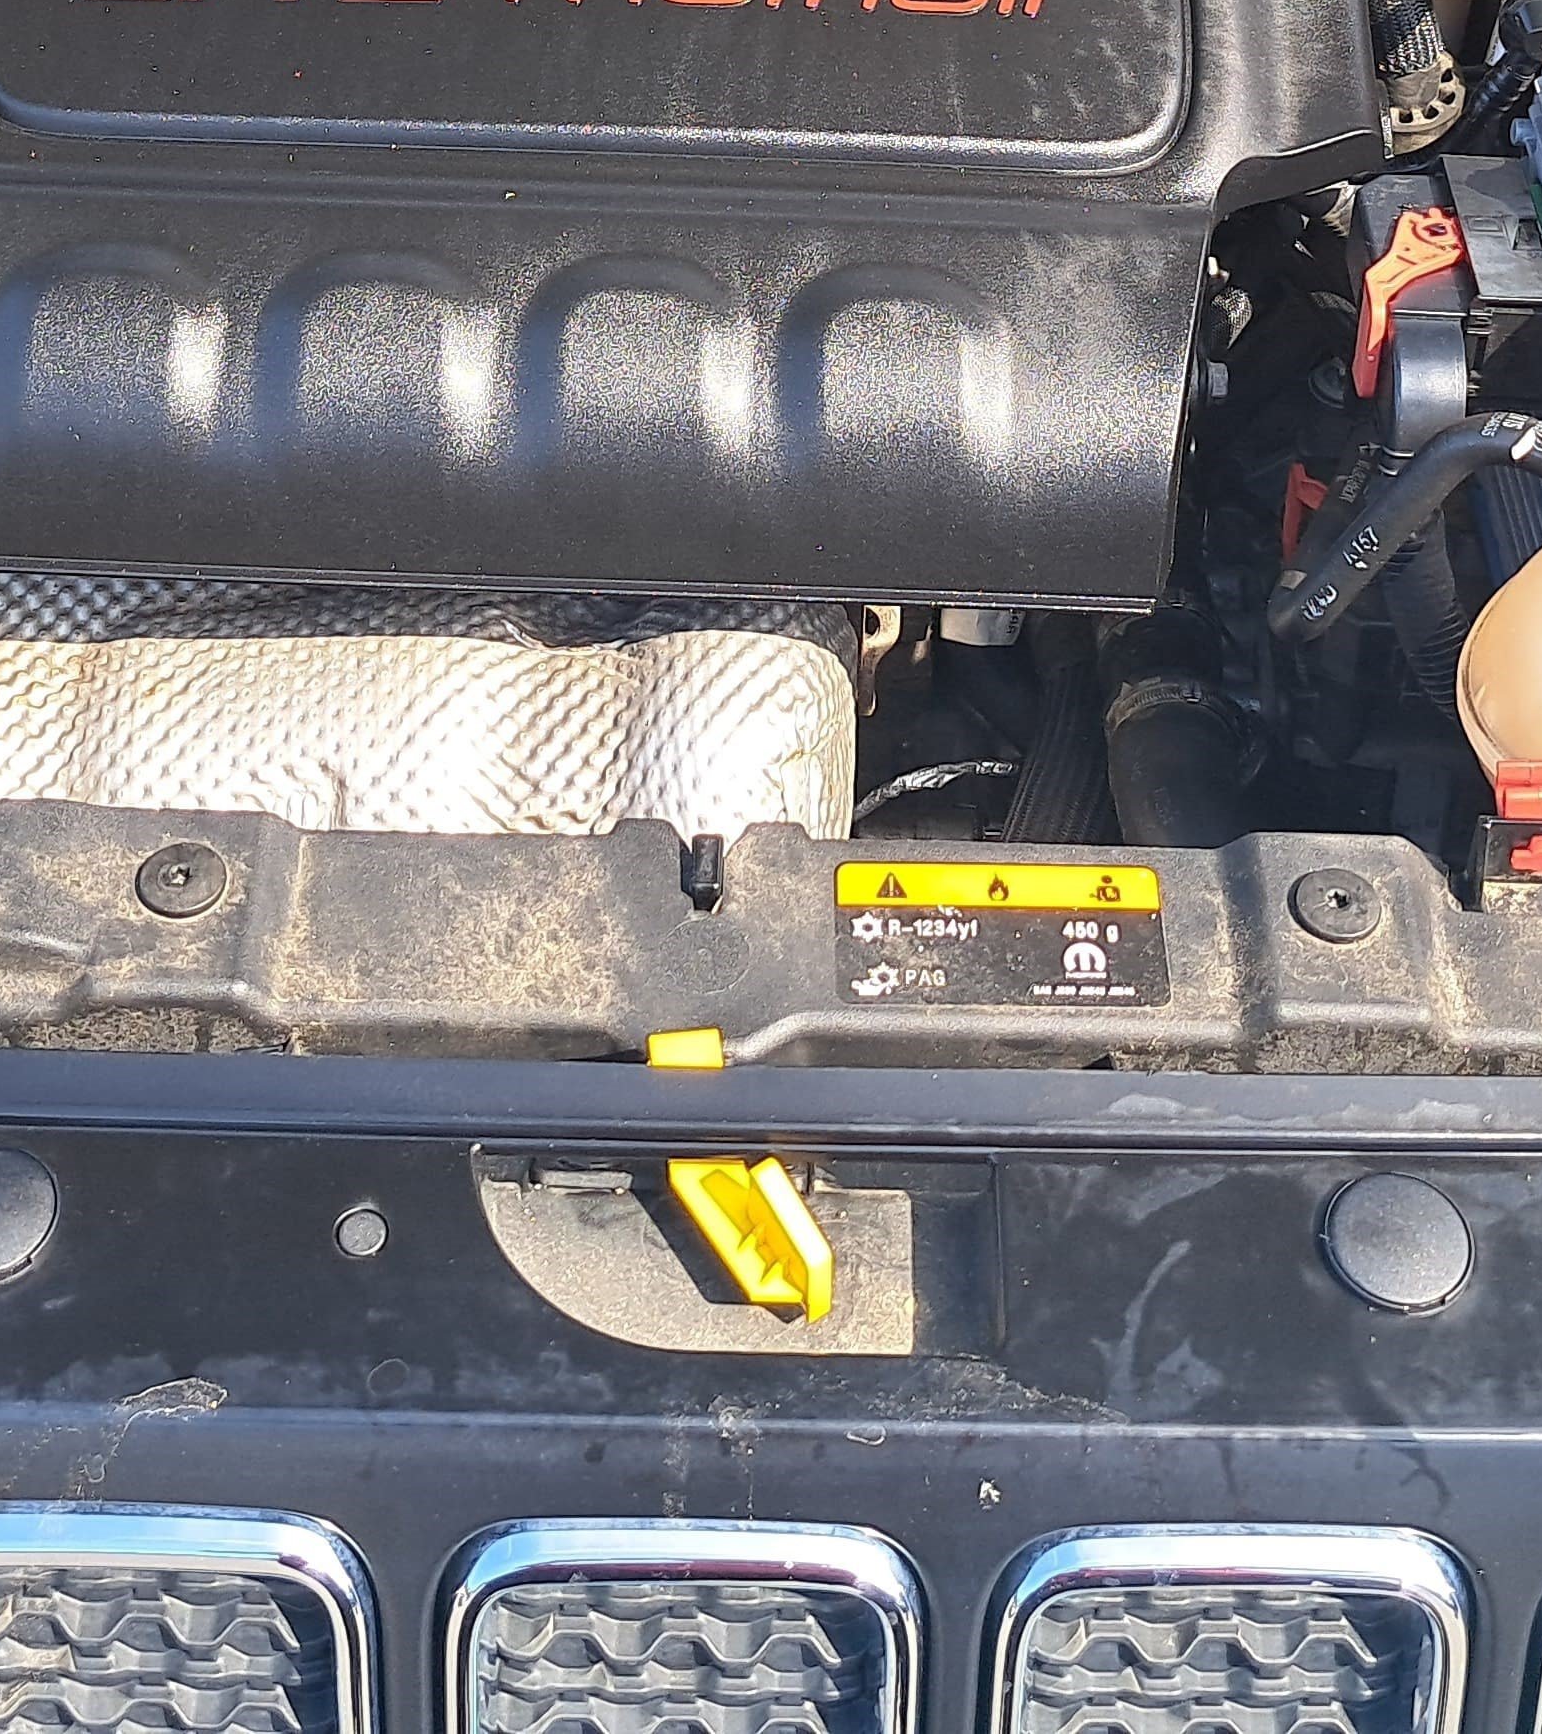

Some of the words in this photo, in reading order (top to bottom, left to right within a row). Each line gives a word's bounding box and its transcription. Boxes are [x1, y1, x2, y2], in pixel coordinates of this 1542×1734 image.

[887, 919, 979, 941] R-1234yf
[1062, 921, 1099, 939] 450
[1106, 925, 1120, 943] g
[905, 969, 947, 986] PAG
